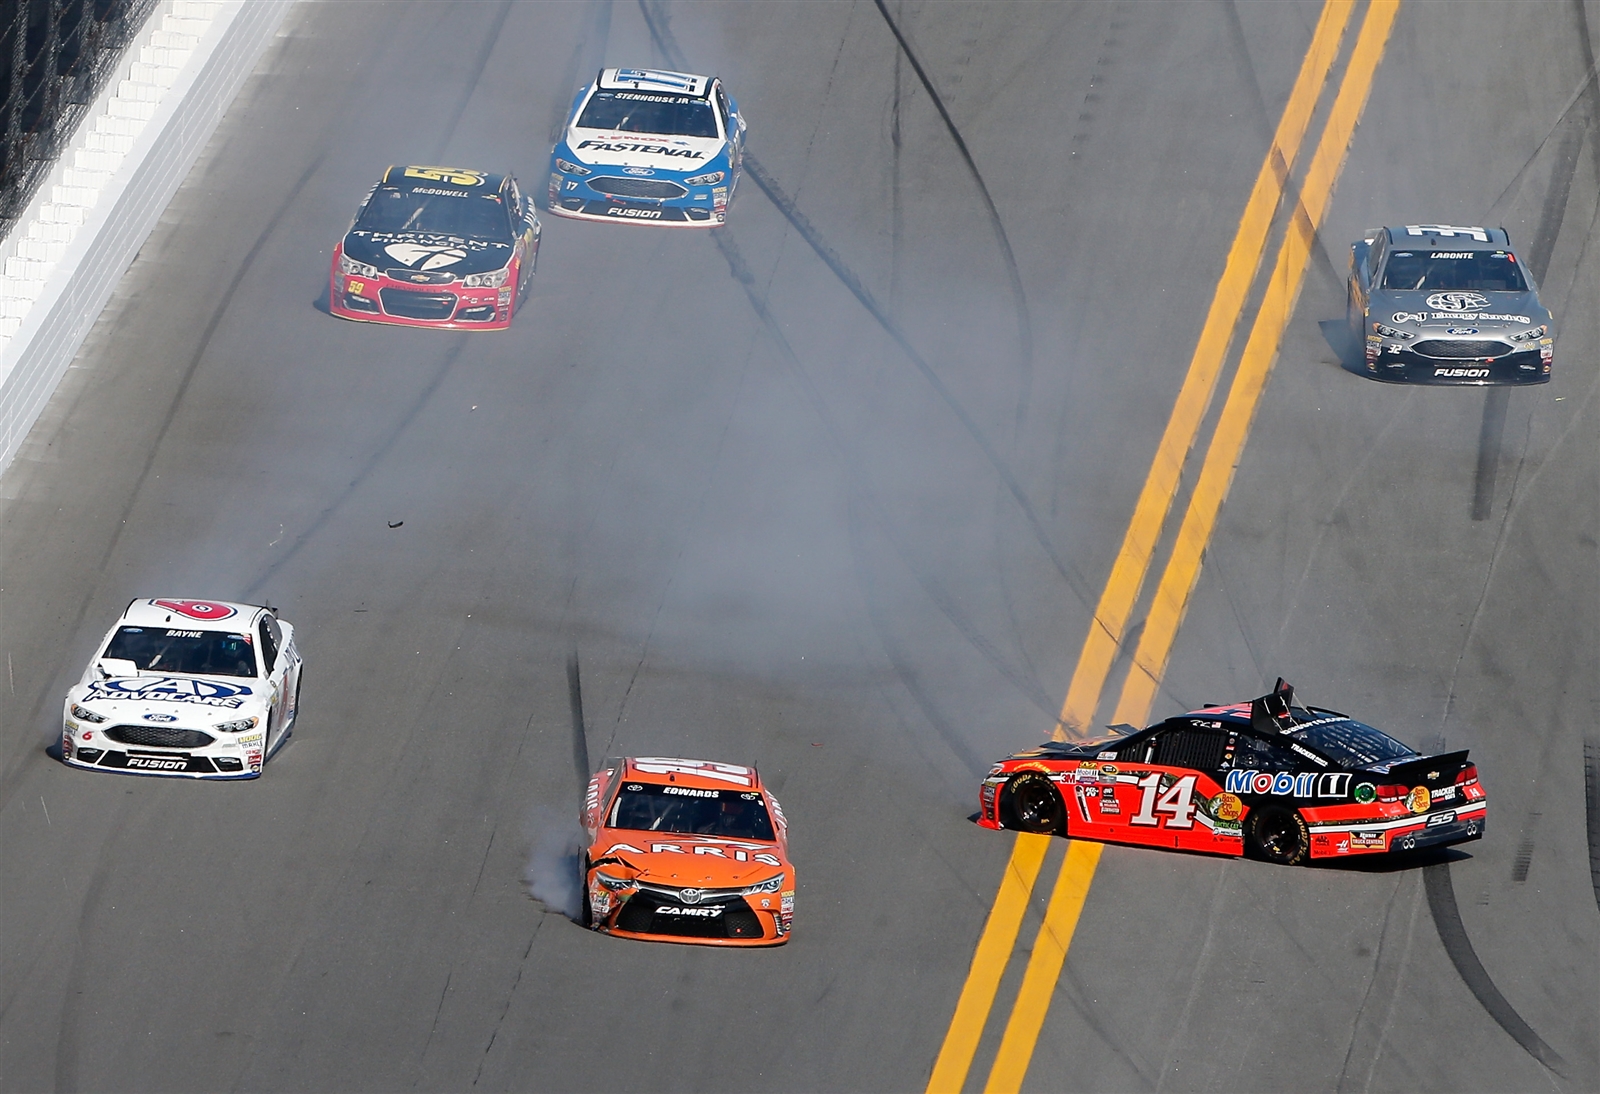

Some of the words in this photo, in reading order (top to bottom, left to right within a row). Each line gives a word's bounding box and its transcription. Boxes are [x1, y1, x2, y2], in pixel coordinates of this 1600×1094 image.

[614, 92, 675, 104] STENHOUSE
[675, 97, 690, 105] JR
[576, 140, 705, 160] FASTENAL
[412, 186, 469, 198] McDOWELL
[566, 181, 579, 191] 17
[607, 207, 662, 219] FUSION
[353, 230, 509, 249] THRIVENT
[370, 237, 482, 251] FINANCIAL
[348, 281, 364, 295] 59
[1431, 312, 1478, 320] Energy
[1479, 313, 1531, 324] Services
[1387, 343, 1403, 354] 32
[1434, 368, 1490, 378] FUSION
[166, 630, 204, 639] BAYNE
[82, 689, 244, 708] ADVOCARE
[82, 731, 94, 740] 6
[127, 759, 188, 771] FUSION
[1061, 773, 1076, 783] 3M
[1225, 768, 1318, 798] Mobil
[663, 787, 720, 798] EDWARDS
[1431, 786, 1455, 798] TRACKER
[1132, 773, 1197, 827] 14
[1222, 794, 1236, 803] Bass
[603, 843, 782, 867] ARRIS
[655, 906, 723, 918] CAMRY
